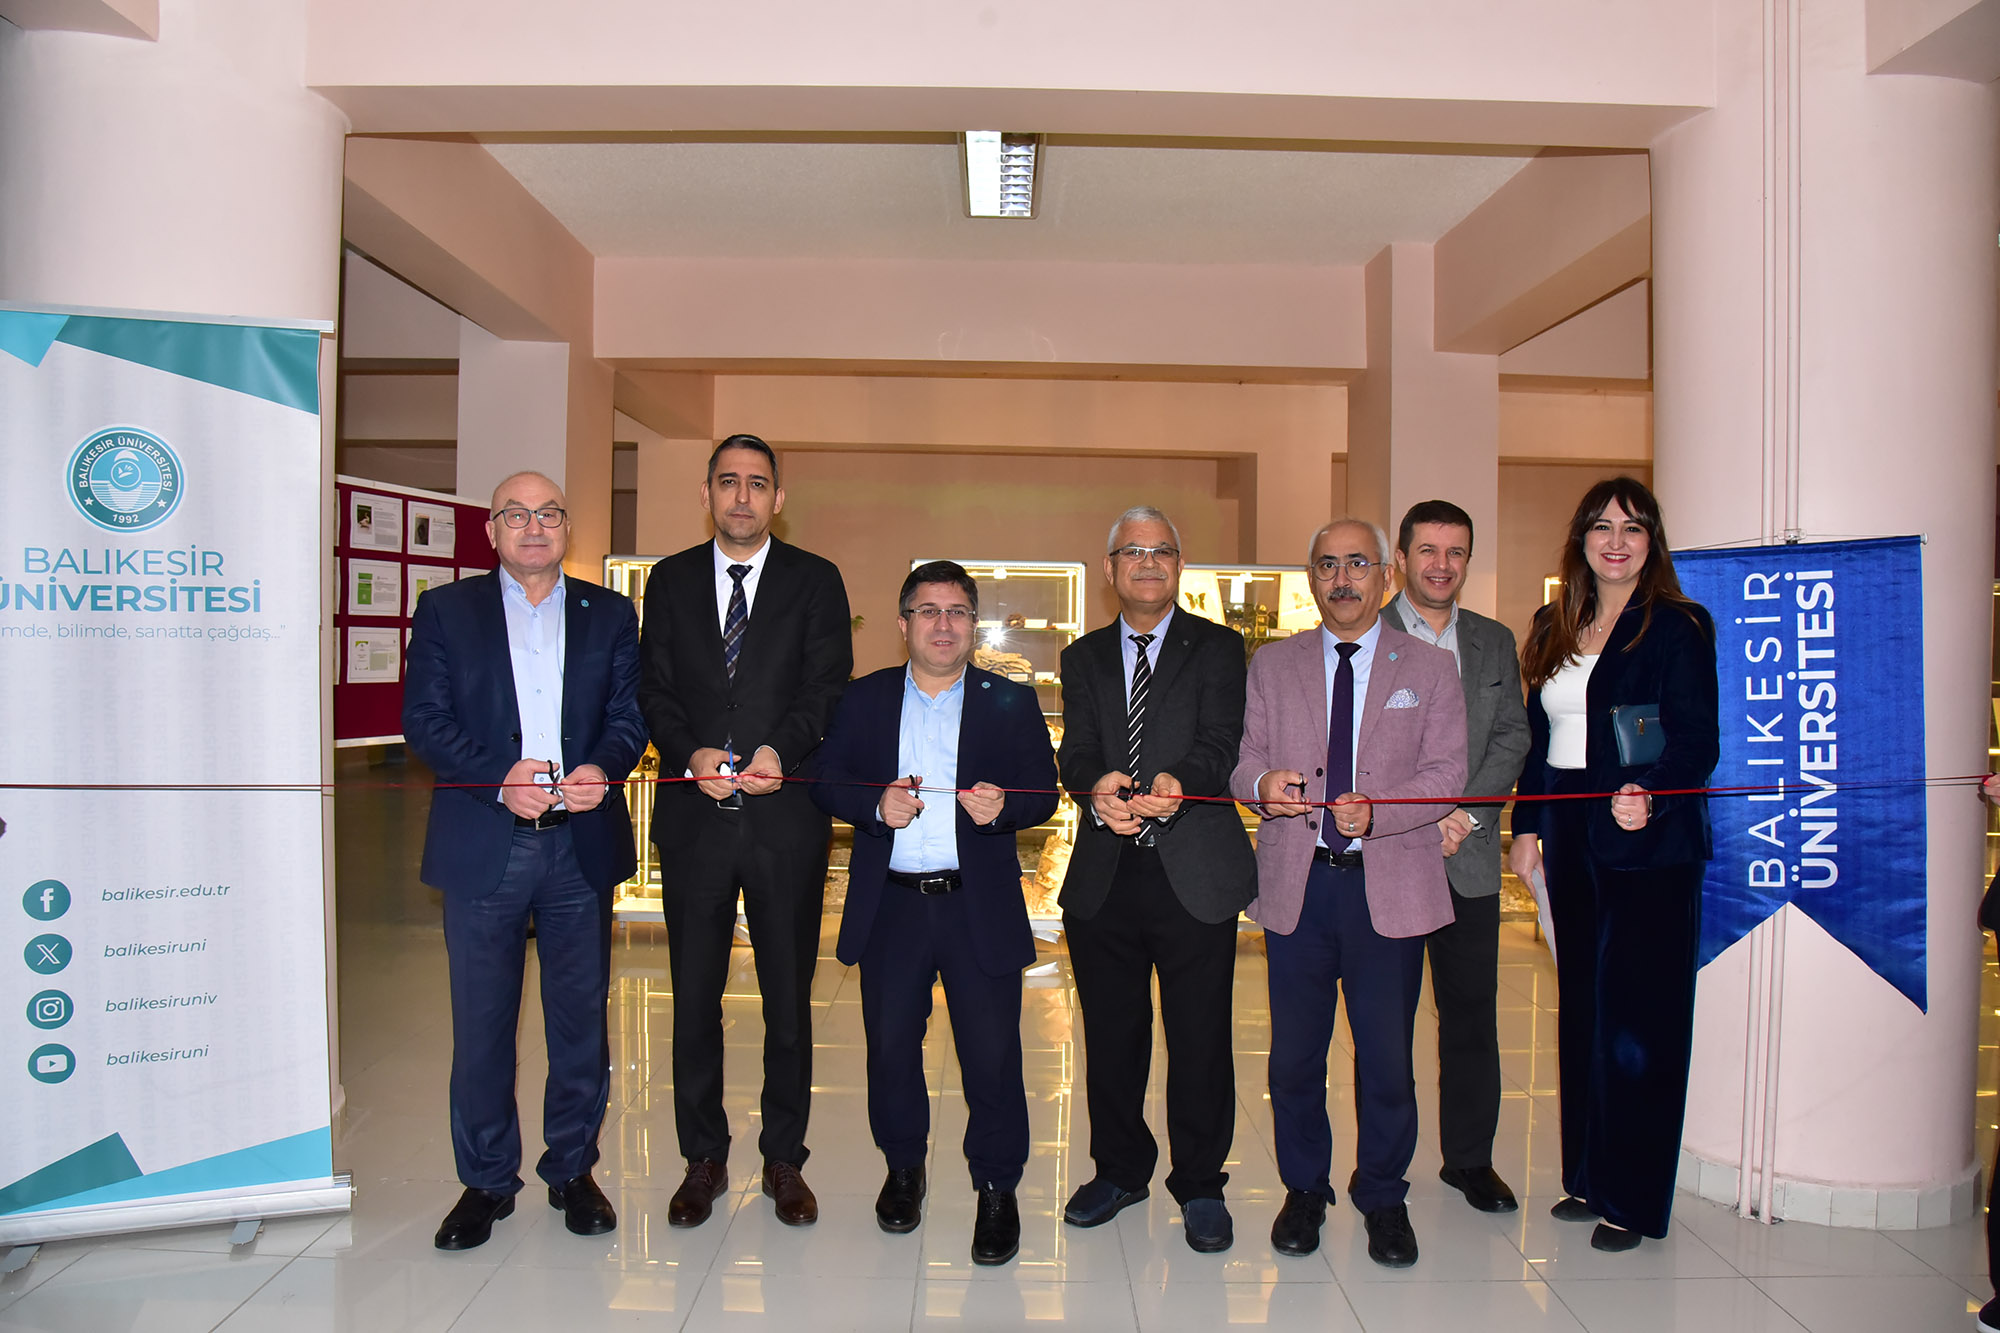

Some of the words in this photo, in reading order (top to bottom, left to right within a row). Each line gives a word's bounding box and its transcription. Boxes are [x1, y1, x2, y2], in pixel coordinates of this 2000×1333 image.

[79, 439, 115, 488] BALIKESİR
[113, 514, 139, 524] 1992
[24, 544, 224, 577] BALIKESİR
[57, 624, 131, 641] bilimde,
[135, 624, 202, 639] sanatta
[1735, 571, 1786, 888] BALIKESİR
[1784, 570, 1838, 889] ÜNİVERSİTESİ
[101, 884, 231, 902] balikesir.edu.tr
[104, 939, 207, 957] balikesiruni
[105, 992, 218, 1013] balikesiruniv
[106, 1045, 209, 1066] balikesiruni
